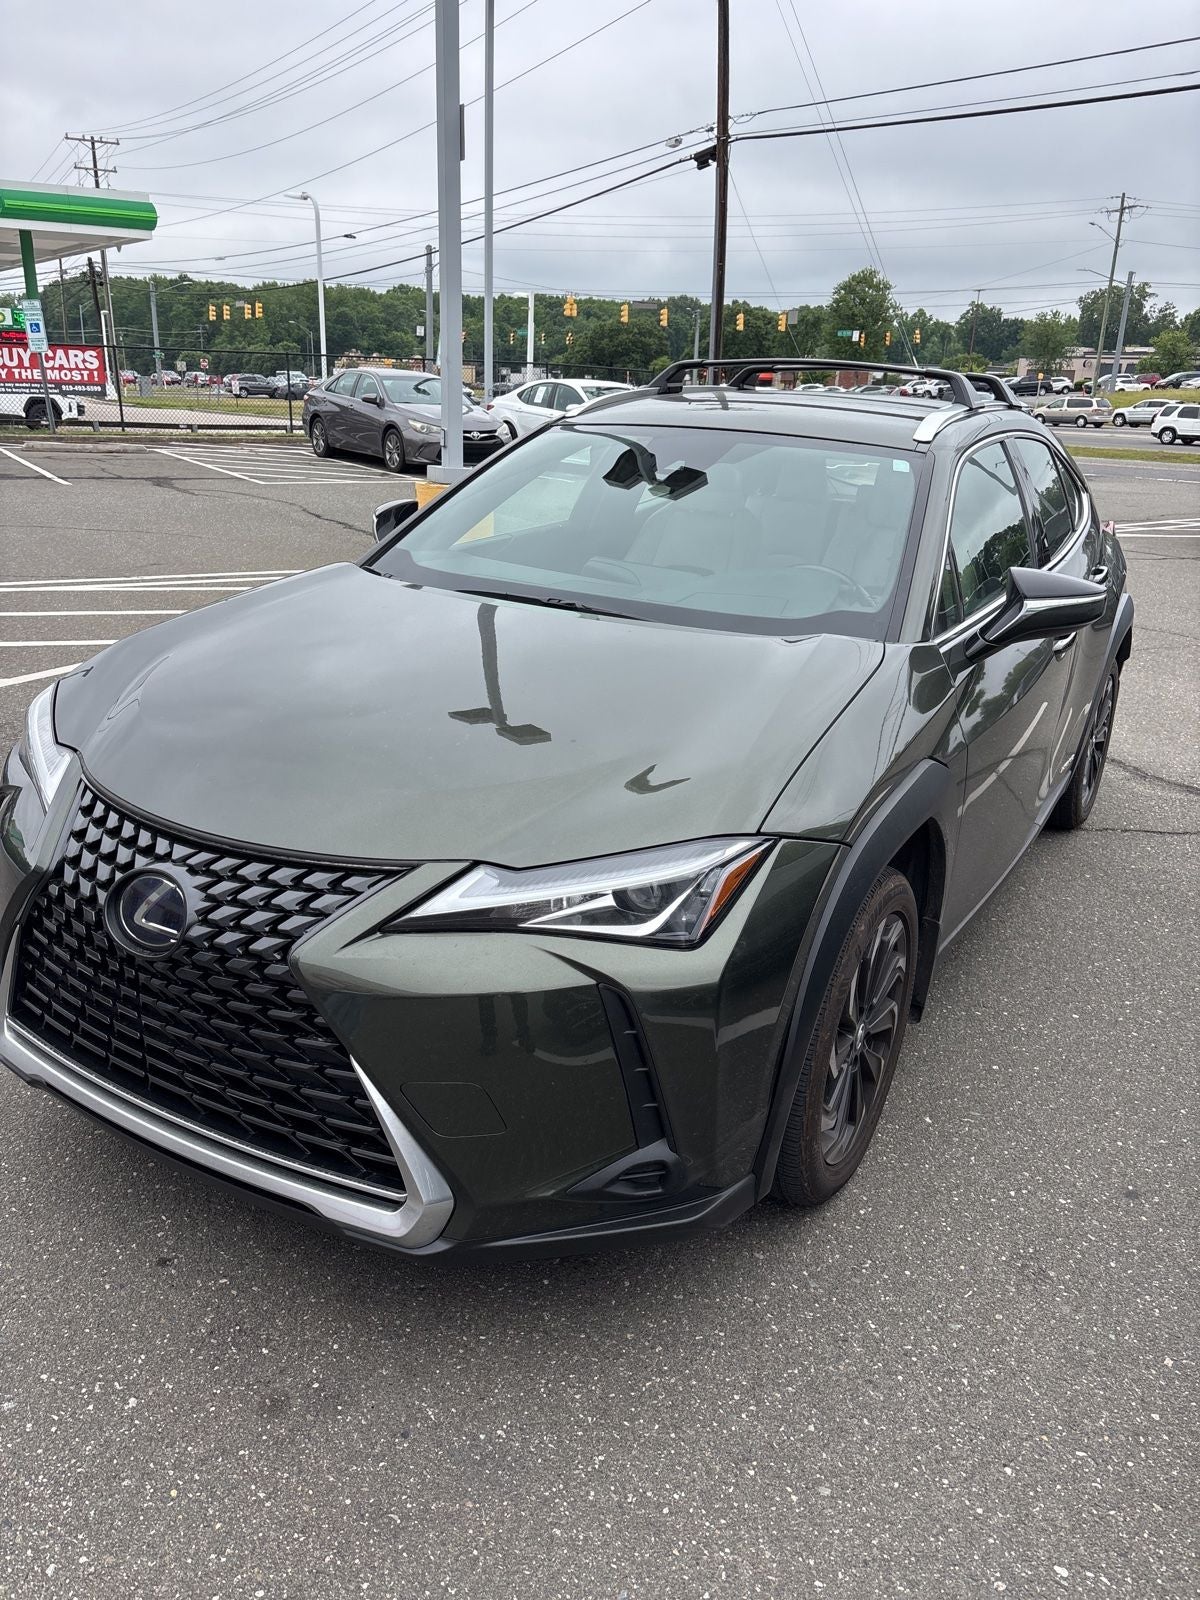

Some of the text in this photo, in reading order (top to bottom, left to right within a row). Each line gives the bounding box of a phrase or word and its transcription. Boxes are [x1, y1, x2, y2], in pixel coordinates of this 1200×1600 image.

[0, 347, 99, 369] UY CARS
[12, 368, 42, 380] THE
[46, 370, 90, 381] MOST
